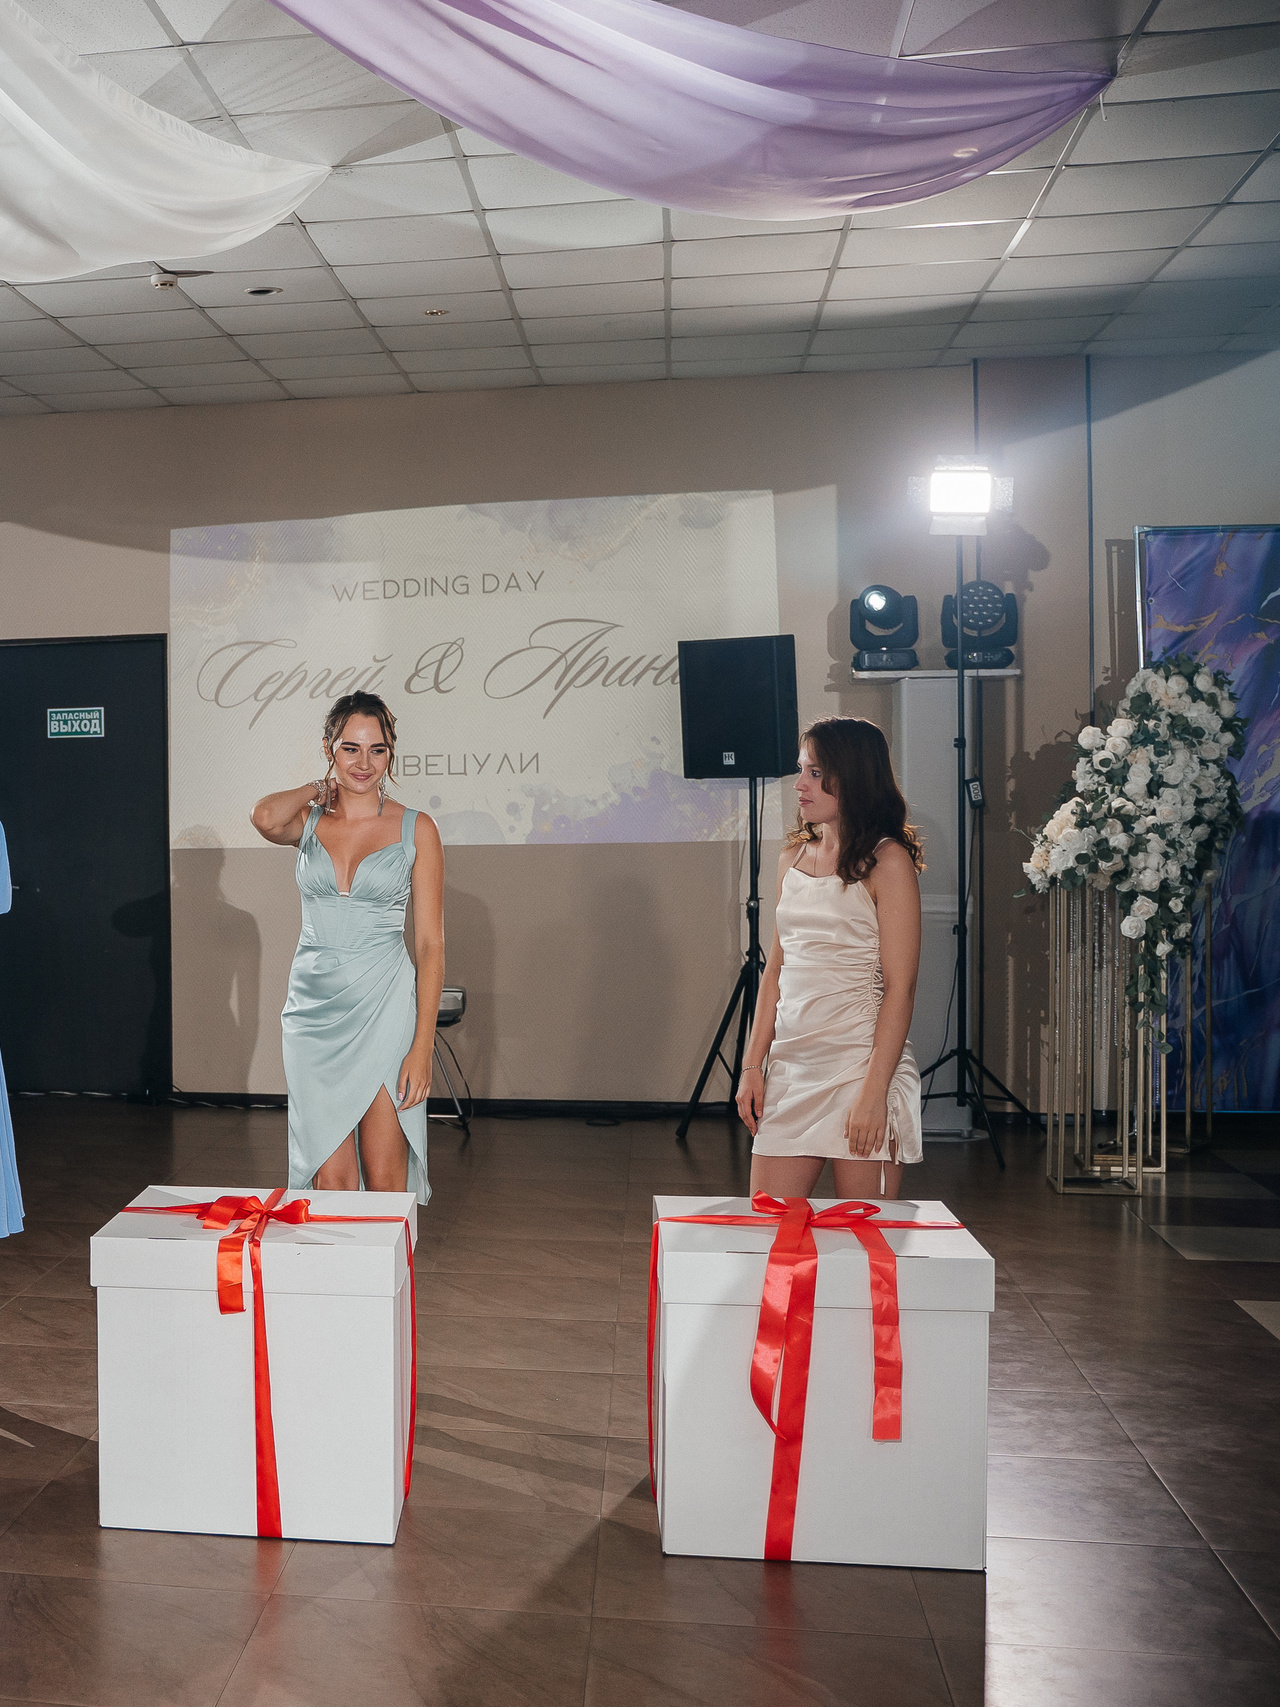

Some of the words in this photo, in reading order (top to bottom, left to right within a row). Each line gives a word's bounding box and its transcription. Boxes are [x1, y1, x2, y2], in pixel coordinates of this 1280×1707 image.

[332, 575, 469, 603] WEDDING
[482, 570, 545, 594] DAY
[197, 638, 394, 731] Сергей
[404, 637, 465, 694] &
[50, 719, 101, 734] ВЫХОД
[51, 711, 100, 721] ЗАПАСНЫЙ
[393, 752, 539, 777] ВЕЦУЛИ
